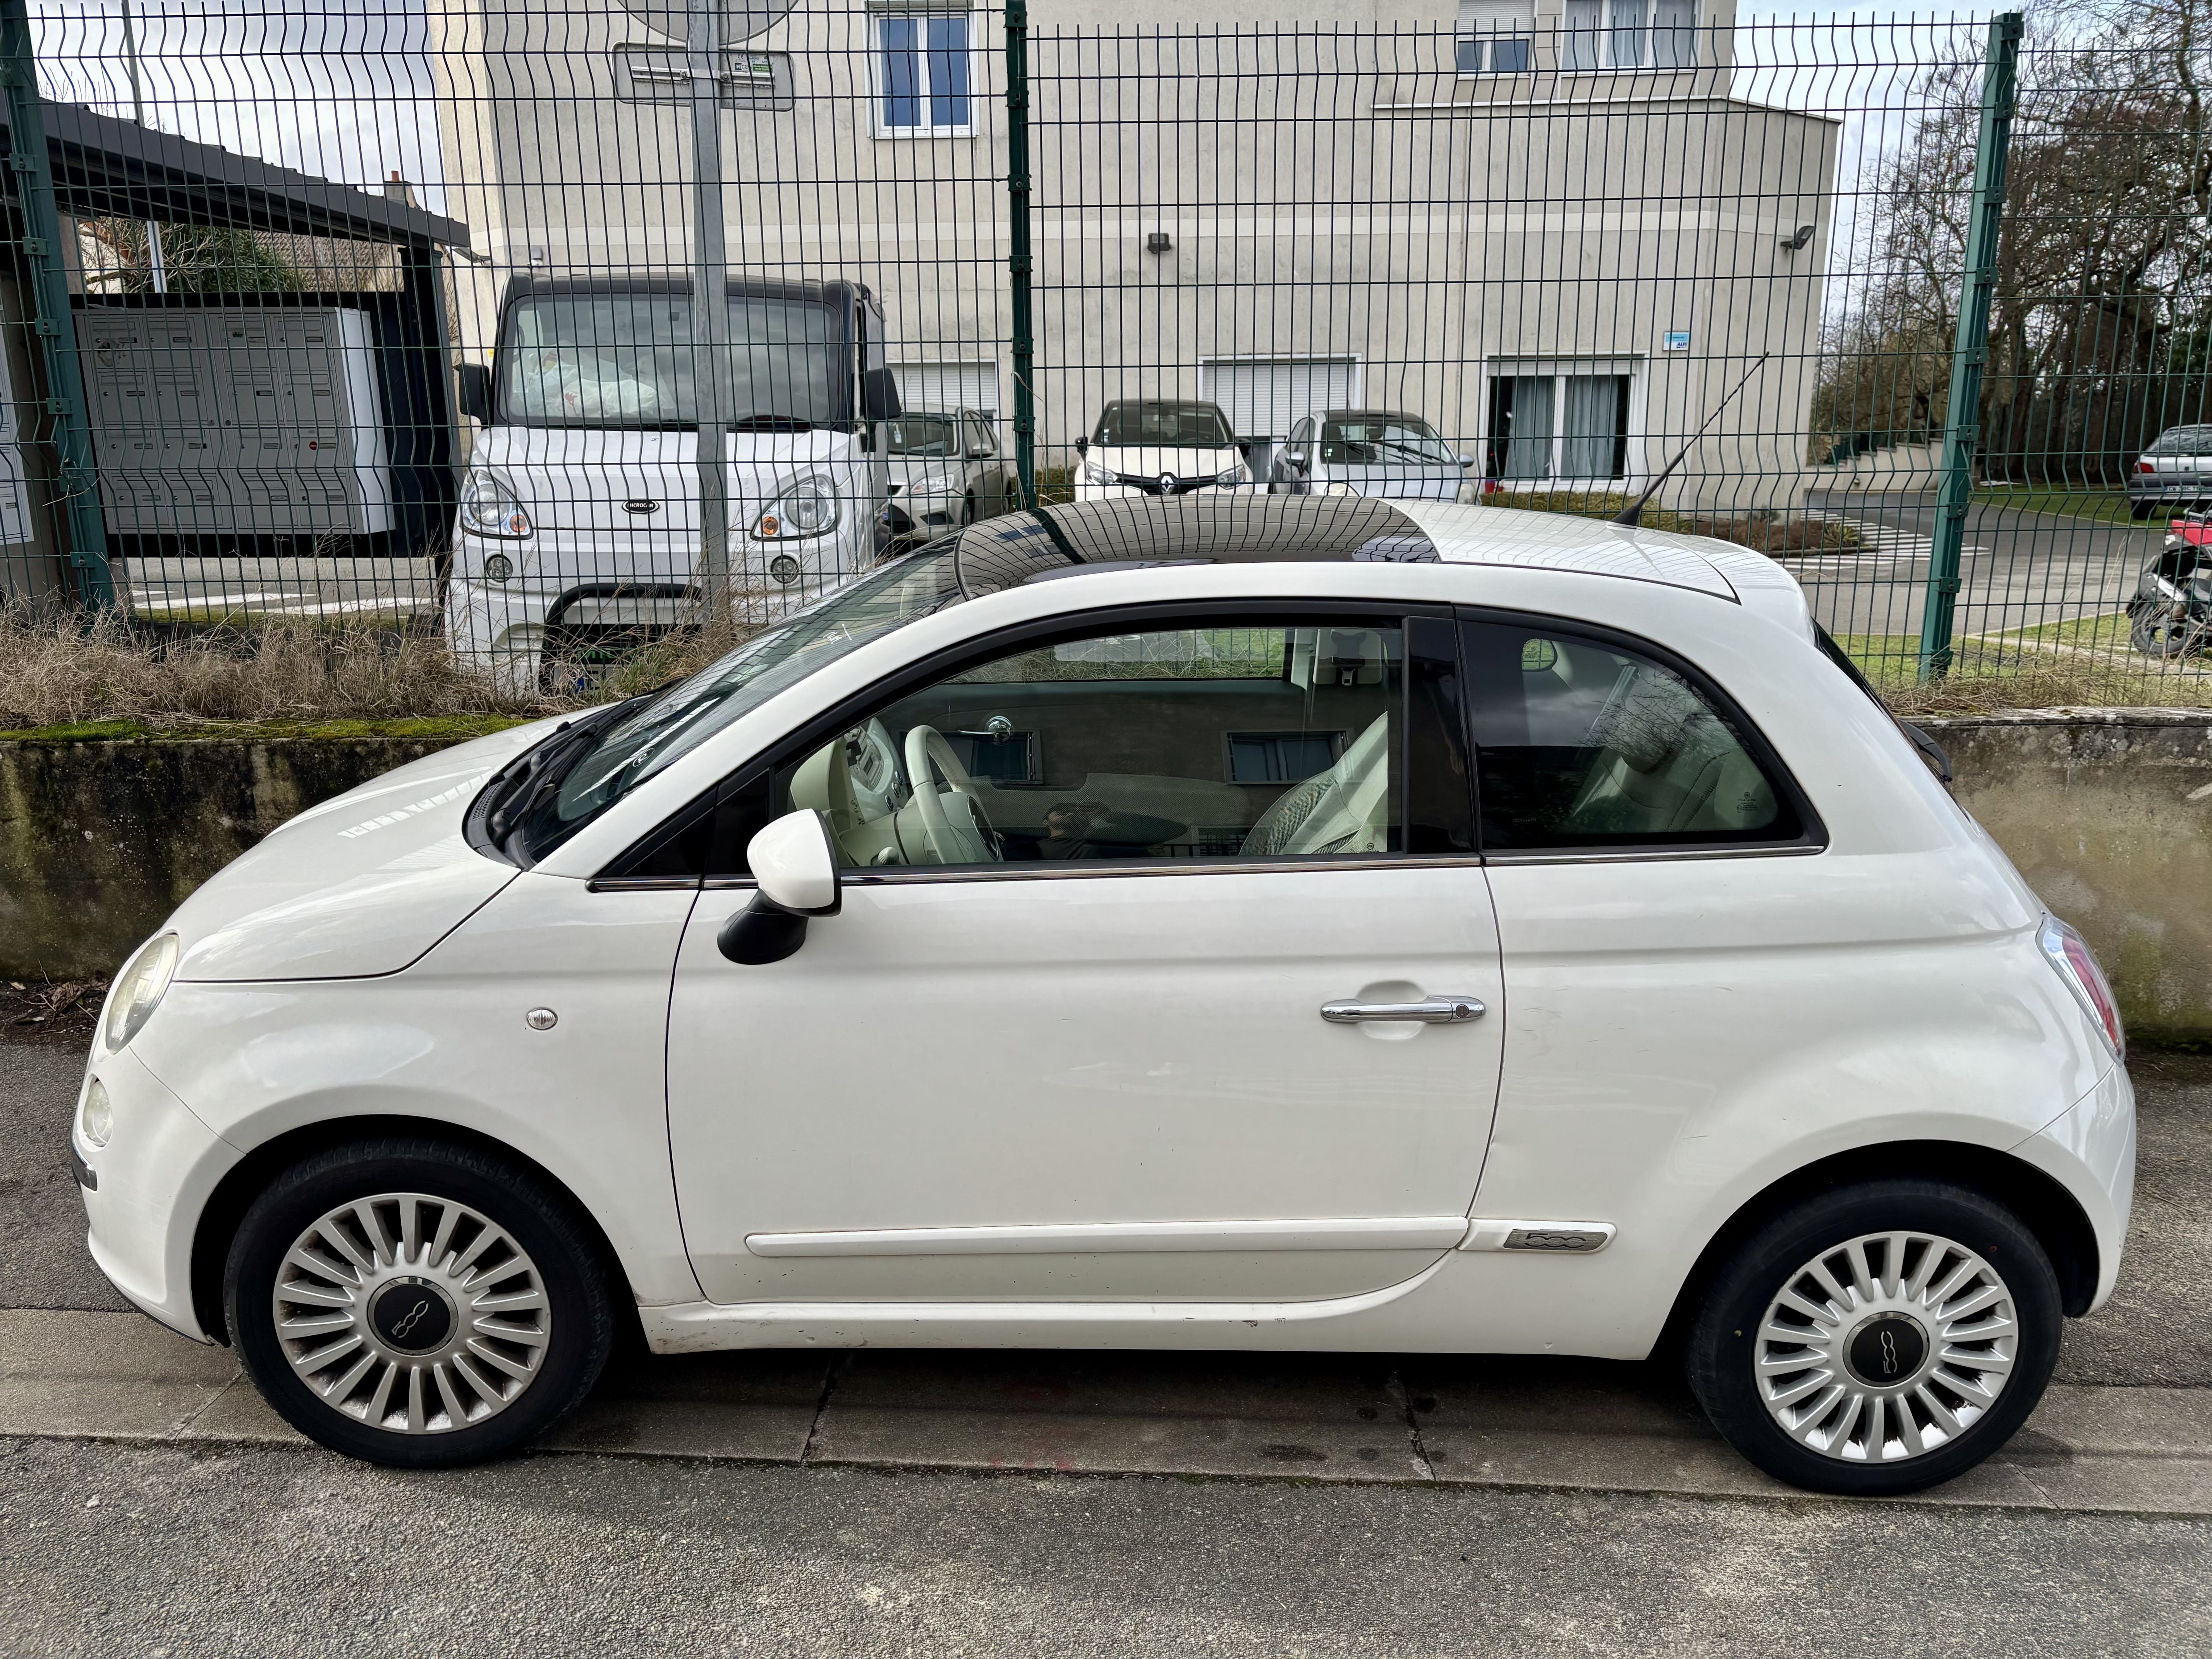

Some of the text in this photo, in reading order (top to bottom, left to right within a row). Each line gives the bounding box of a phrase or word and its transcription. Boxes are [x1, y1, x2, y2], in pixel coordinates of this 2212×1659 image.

[1525, 1233, 1587, 1249] 500
[391, 1300, 429, 1338] 500
[1881, 1331, 1897, 1374] 500
